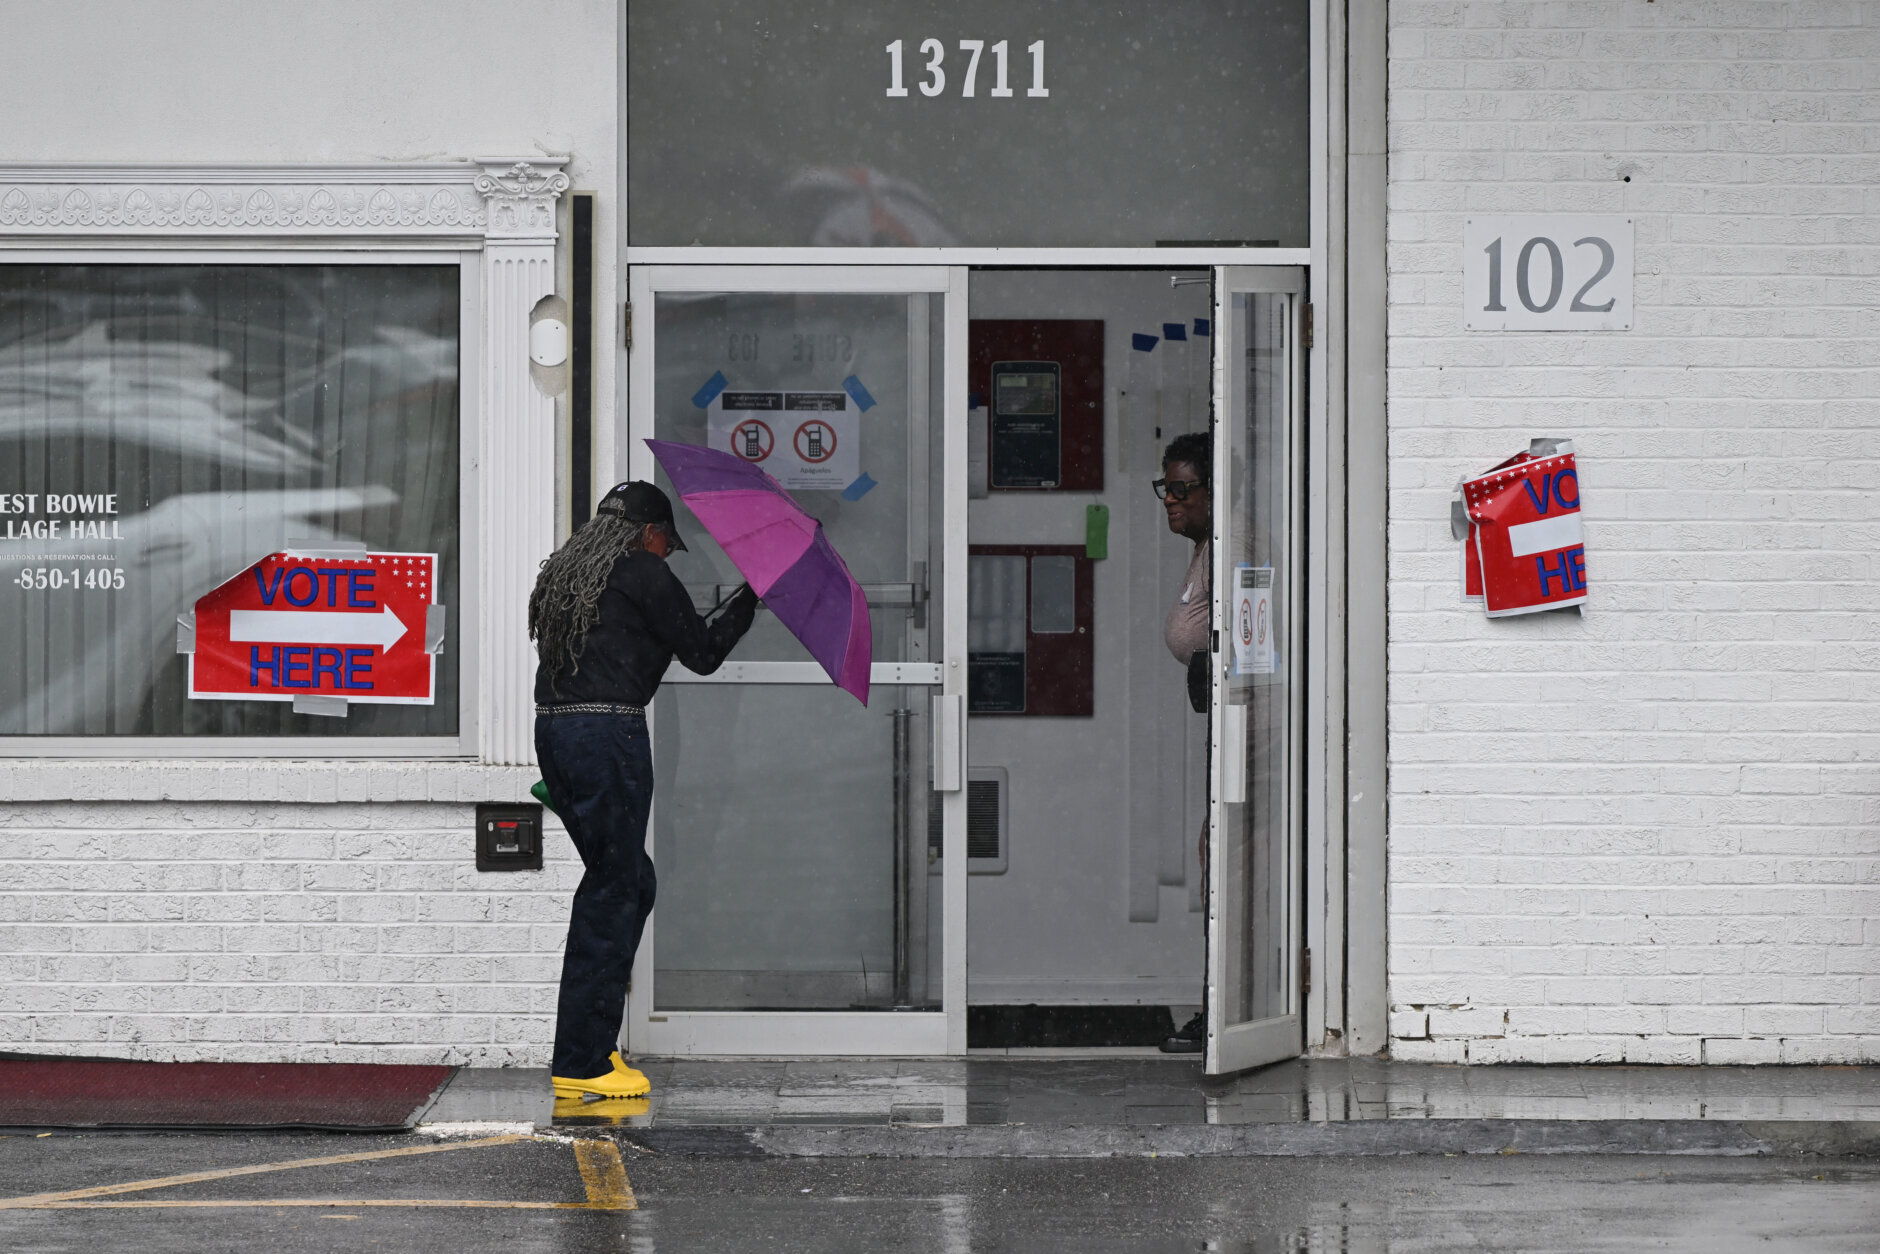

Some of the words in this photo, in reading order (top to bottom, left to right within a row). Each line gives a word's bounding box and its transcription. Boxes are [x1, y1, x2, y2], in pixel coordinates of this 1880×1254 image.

[885, 38, 1049, 97] 13711
[1483, 236, 1616, 313] 102
[46, 494, 119, 514] BOWIE
[70, 520, 125, 540] HALL
[14, 567, 126, 590] -850-1405
[253, 566, 377, 608] VOTE
[250, 645, 375, 690] HERE
